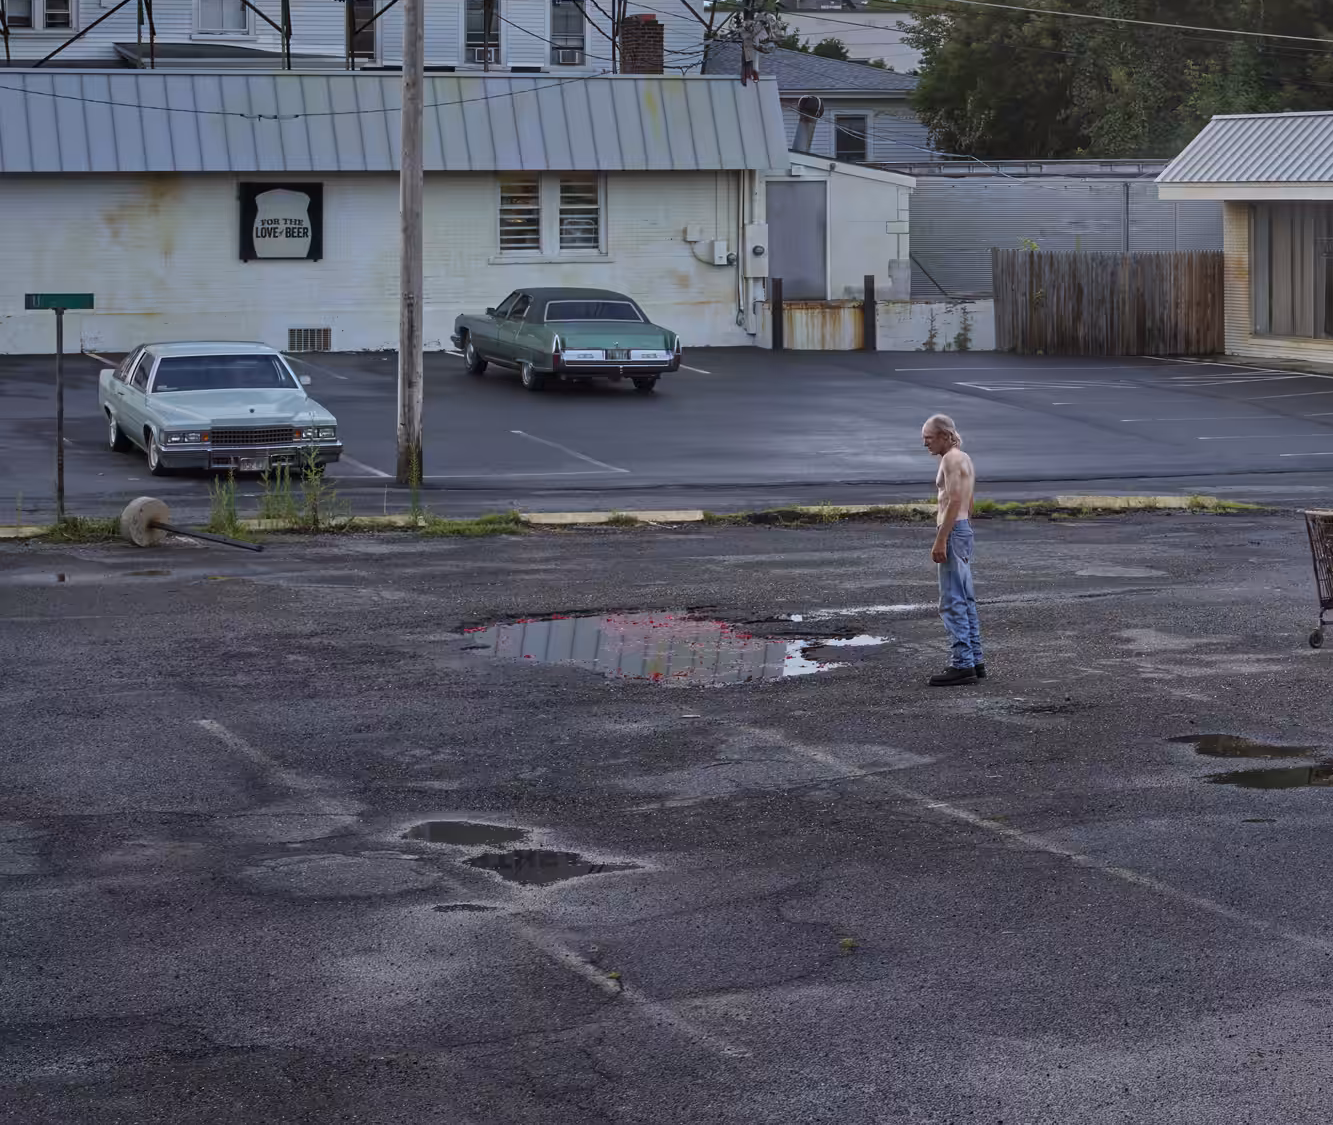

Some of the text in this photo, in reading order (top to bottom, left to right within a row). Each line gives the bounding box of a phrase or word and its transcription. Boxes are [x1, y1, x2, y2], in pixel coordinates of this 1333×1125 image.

[260, 218, 304, 226] FOR THE
[255, 227, 279, 238] LOVE
[285, 227, 309, 238] BEER
